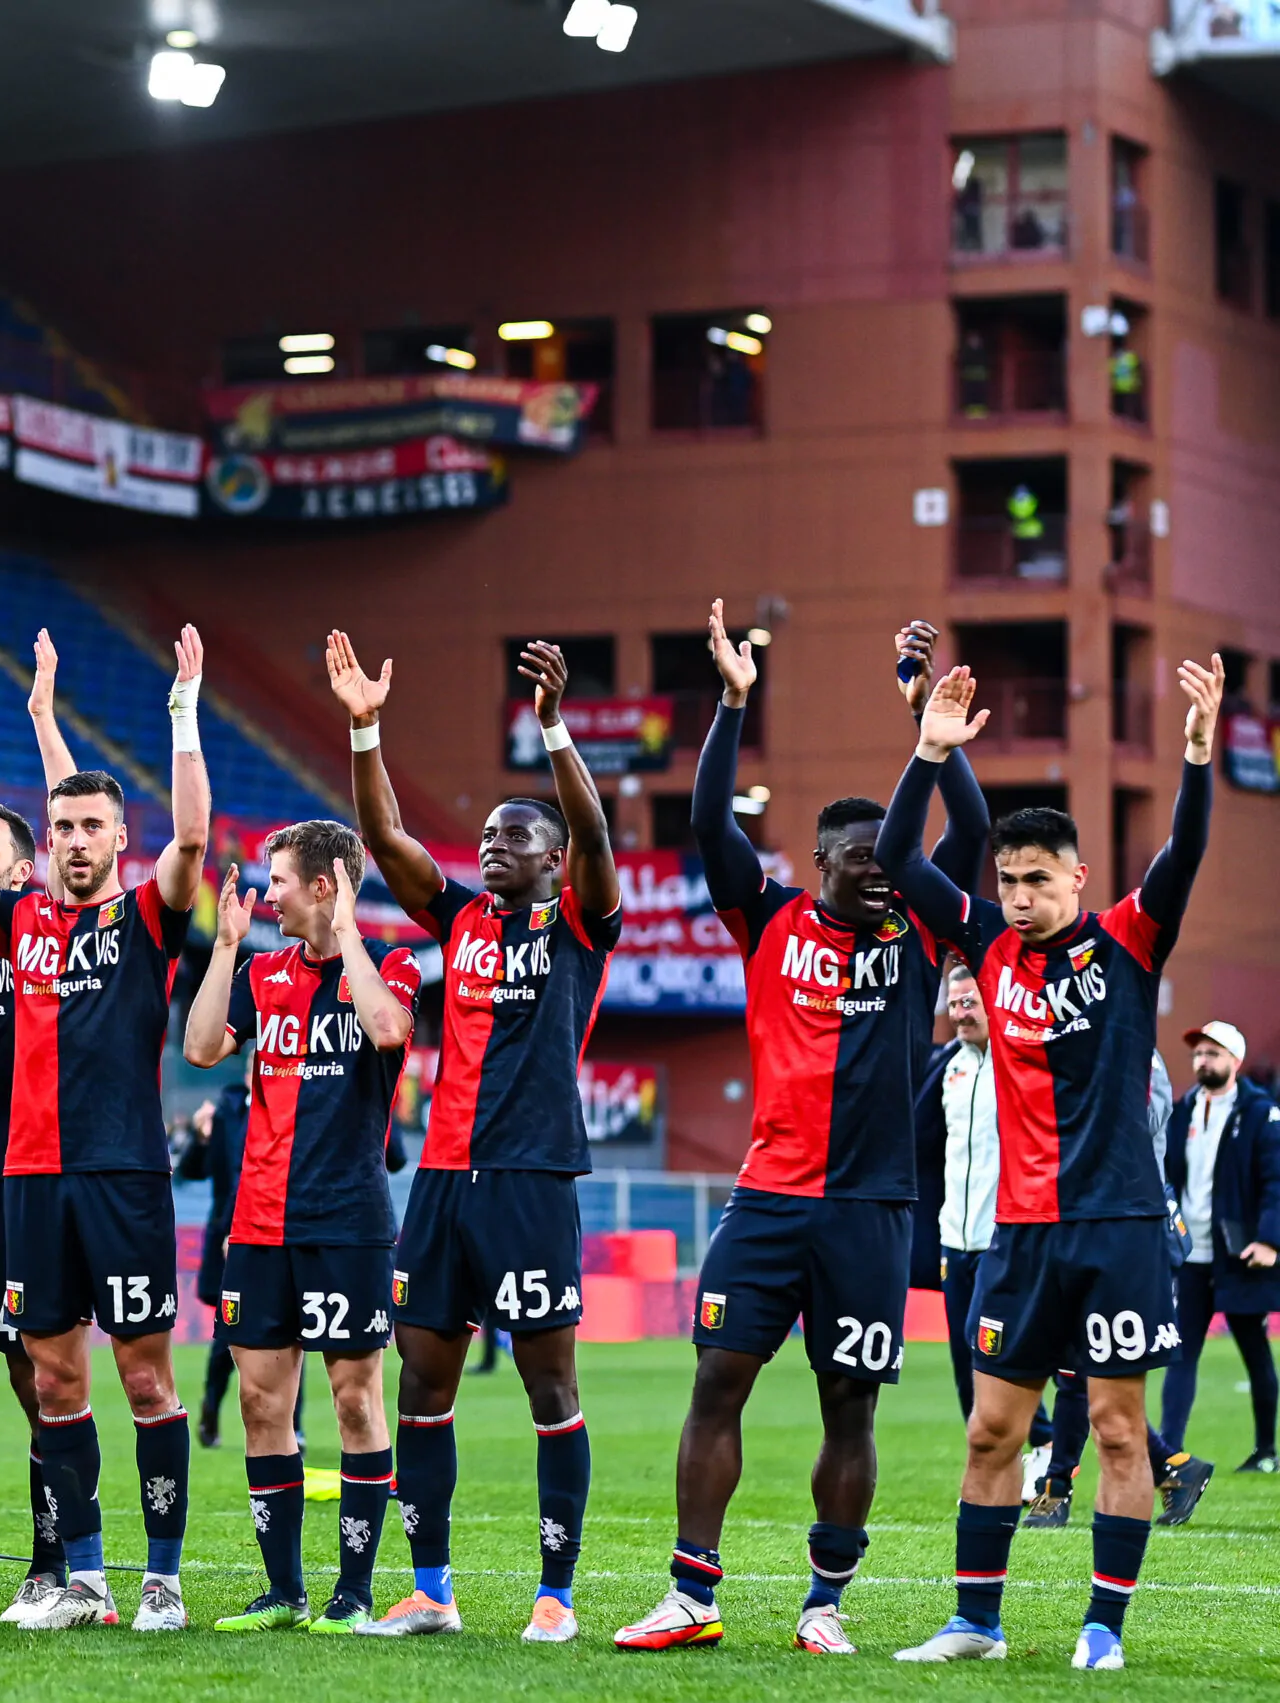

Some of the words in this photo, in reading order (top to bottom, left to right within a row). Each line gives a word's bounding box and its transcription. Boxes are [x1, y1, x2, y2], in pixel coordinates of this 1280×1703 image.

[107, 1276, 152, 1323] 13
[301, 1291, 351, 1339] 32
[494, 1269, 551, 1320] 45
[832, 1316, 892, 1371] 20
[1086, 1310, 1146, 1363] 99
